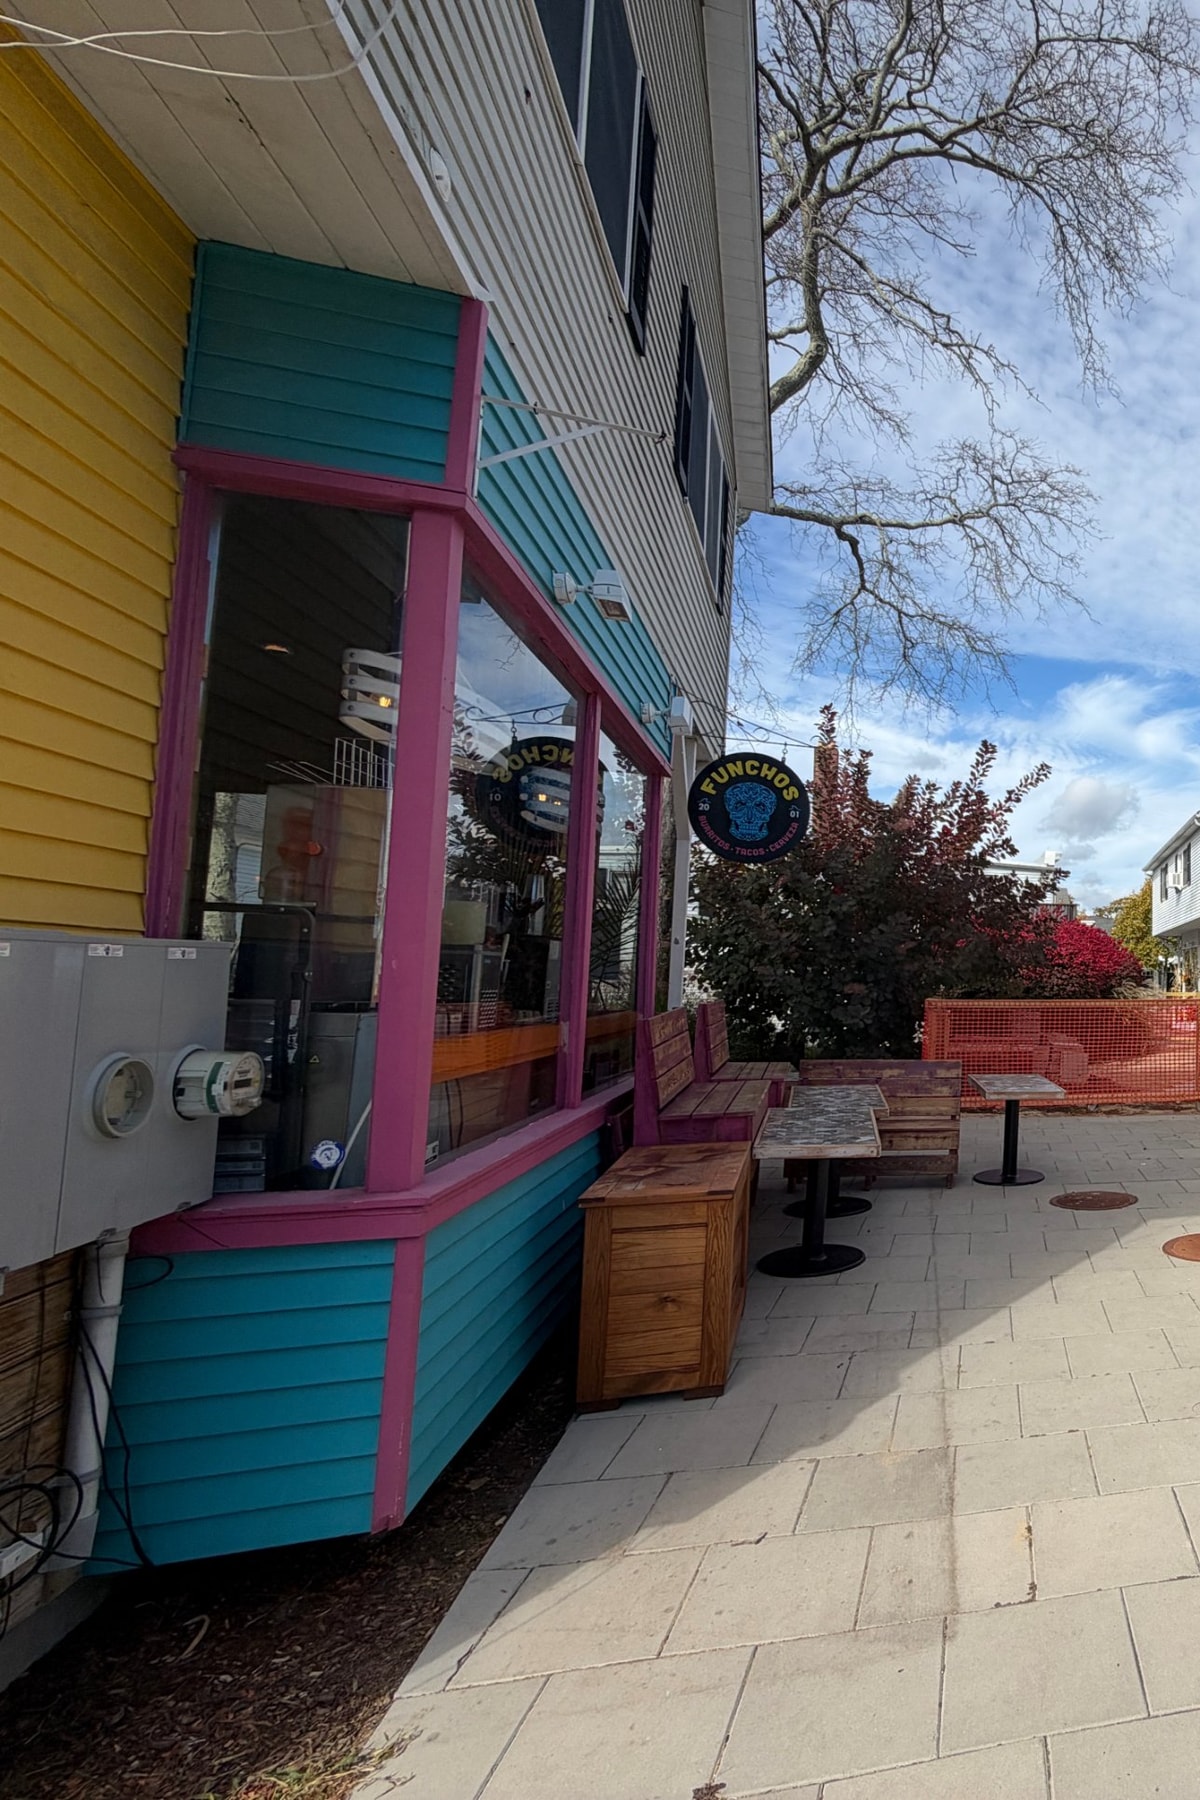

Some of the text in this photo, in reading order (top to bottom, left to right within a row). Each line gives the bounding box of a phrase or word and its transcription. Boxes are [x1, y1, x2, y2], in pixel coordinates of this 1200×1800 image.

[700, 760, 800, 801] FUNCHOS
[698, 803, 710, 811] 20
[698, 815, 800, 856] BURRITOS TACOS CERVEZA
